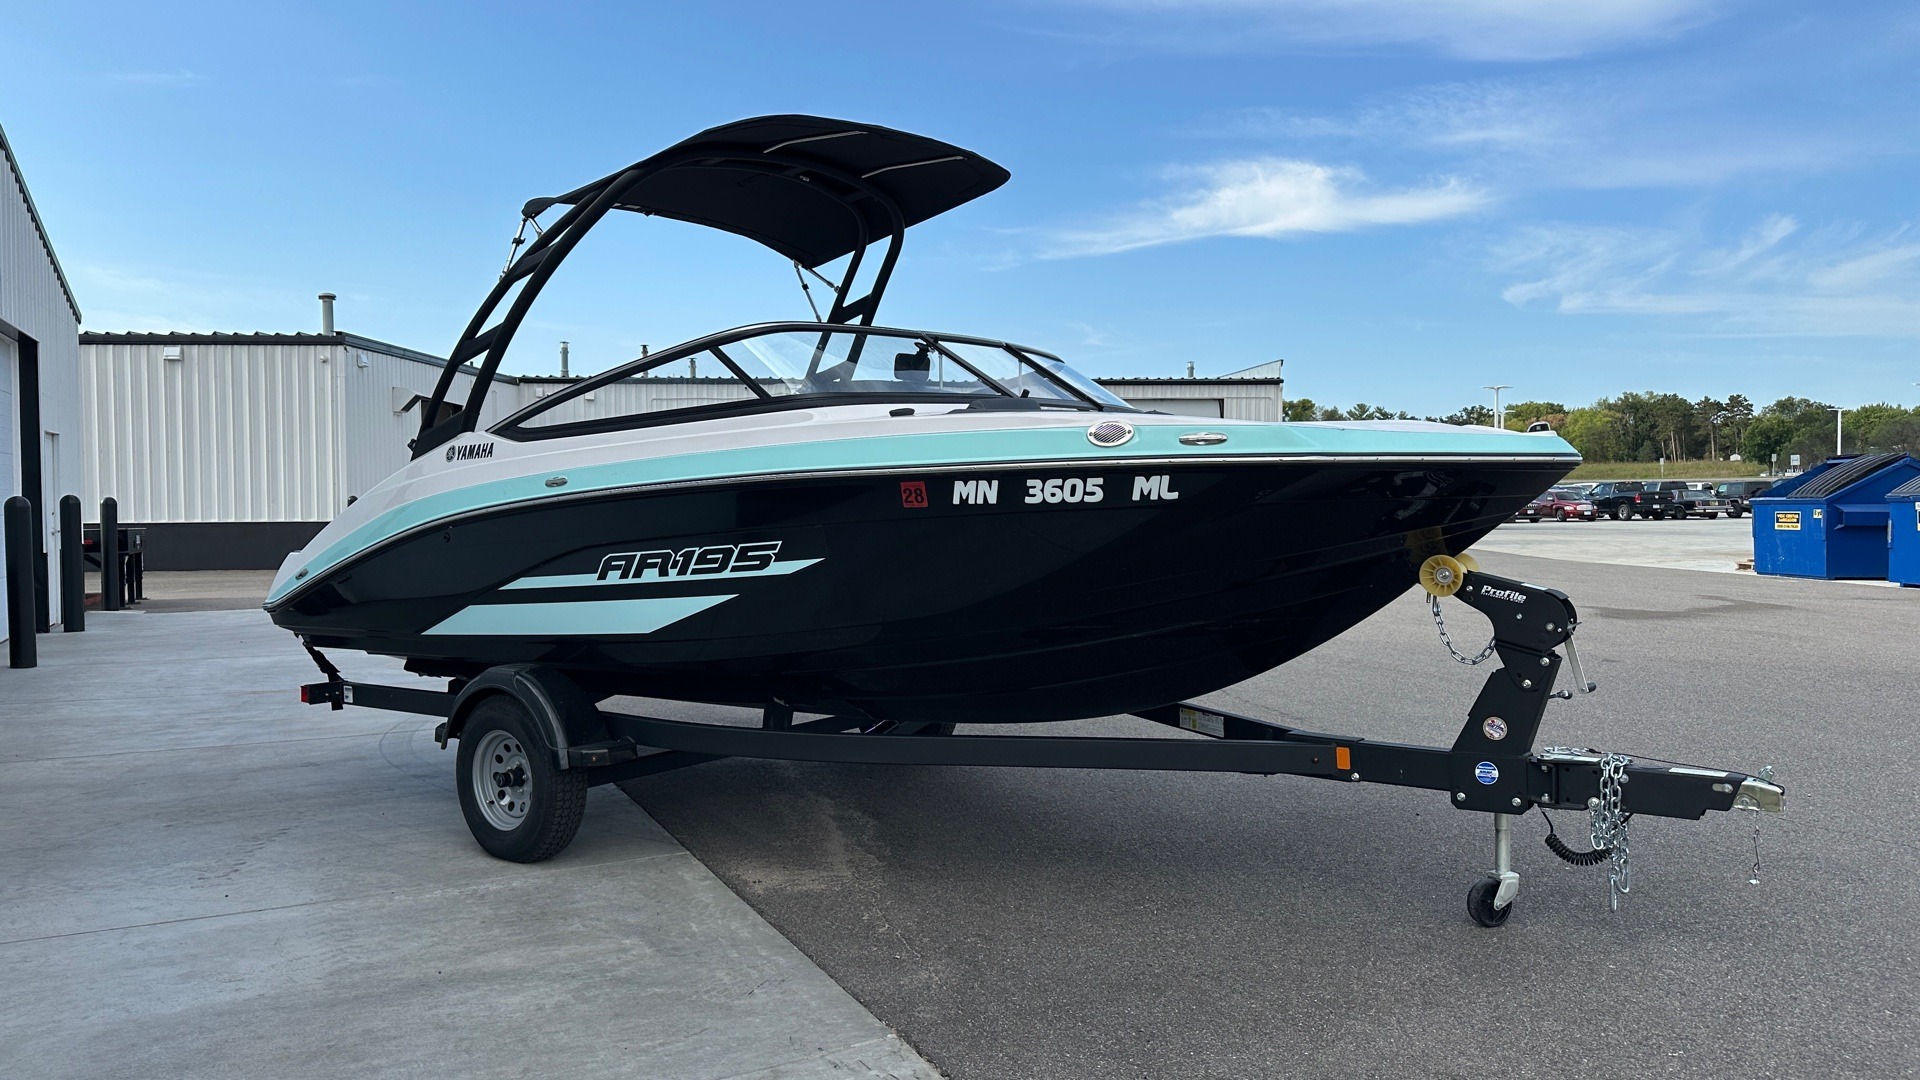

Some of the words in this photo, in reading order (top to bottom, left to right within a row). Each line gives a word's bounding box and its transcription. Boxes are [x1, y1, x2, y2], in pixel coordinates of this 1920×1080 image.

[456, 442, 495, 461] YAMAHA
[902, 487, 925, 505] 28
[952, 480, 998, 505] MN
[1024, 477, 1104, 504] 3605
[1131, 475, 1179, 502] ML
[596, 540, 783, 581] AR195
[1481, 585, 1527, 601] Profile
